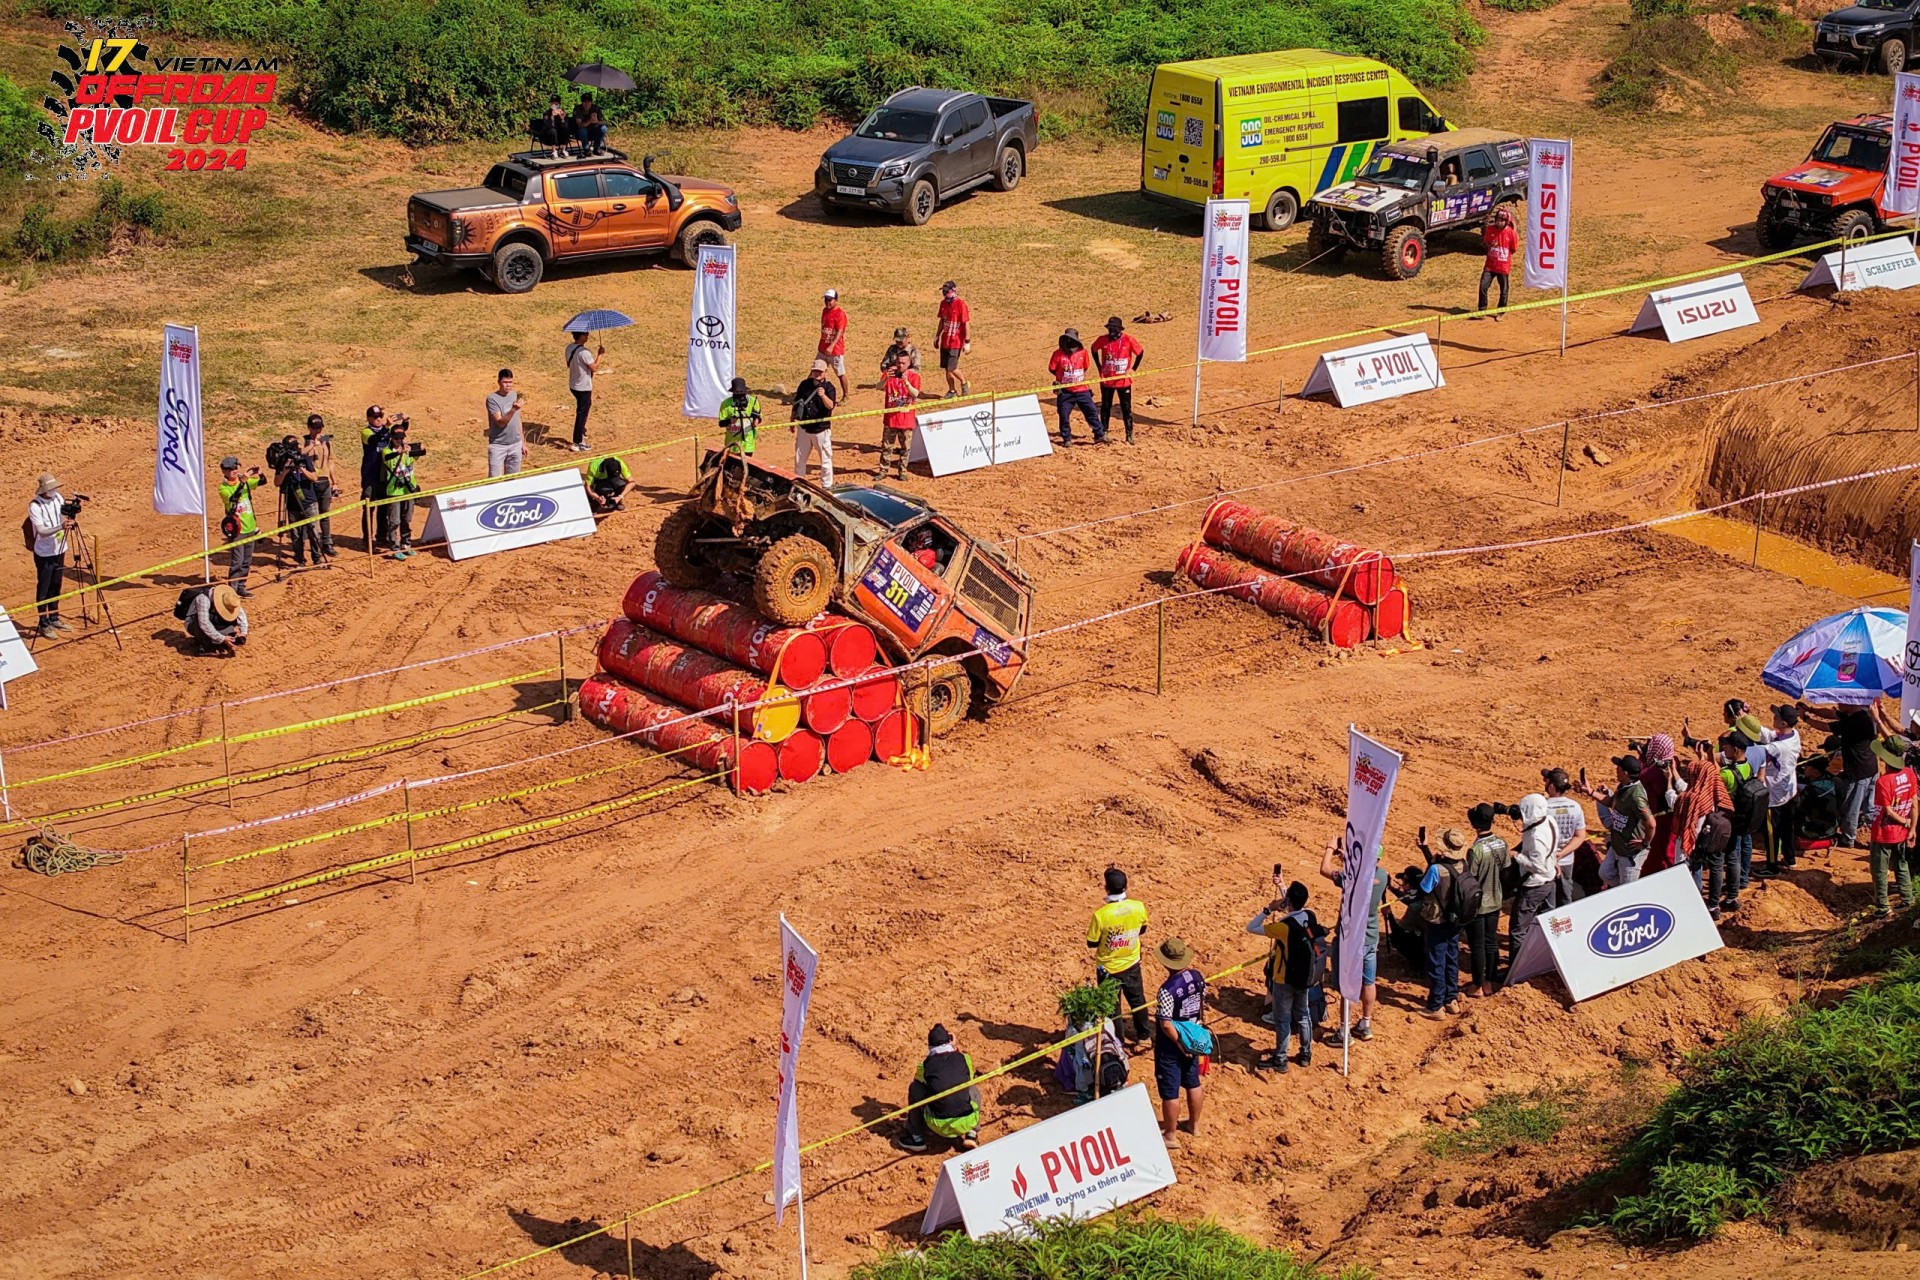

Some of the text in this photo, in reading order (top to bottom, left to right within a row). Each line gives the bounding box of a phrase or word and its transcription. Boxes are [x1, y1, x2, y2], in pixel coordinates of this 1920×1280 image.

[1228, 69, 1389, 97] VIETNAM ENVIRONMENTAL INCIDENT RESPONSE CENTER
[1264, 110, 1316, 124] OIL-CHEMICAL SPILL
[1264, 122, 1325, 136] EMERGENCY RESPONSE
[1283, 134, 1295, 143] 1800
[1897, 141, 1920, 192] PVOIL
[1539, 183, 1556, 269] ISUZU
[1865, 257, 1918, 277] SCHAEFFLER
[1215, 278, 1240, 337] PVOIL
[1677, 298, 1737, 325] ISUZU
[690, 338, 731, 350] TOYOTA
[1371, 350, 1420, 379] PVOIL
[162, 387, 190, 475] Ford
[962, 444, 984, 459] Move
[1003, 435, 1021, 448] world
[494, 500, 543, 527] Ford
[892, 564, 916, 593] PVOIL
[885, 580, 909, 609] 311
[1607, 912, 1659, 952] Ford
[1041, 1127, 1131, 1194] PVOIL
[1086, 1184, 1097, 1194] xa
[1097, 1174, 1119, 1190] thêm
[1005, 1192, 1050, 1218] PETROVIETNAM
